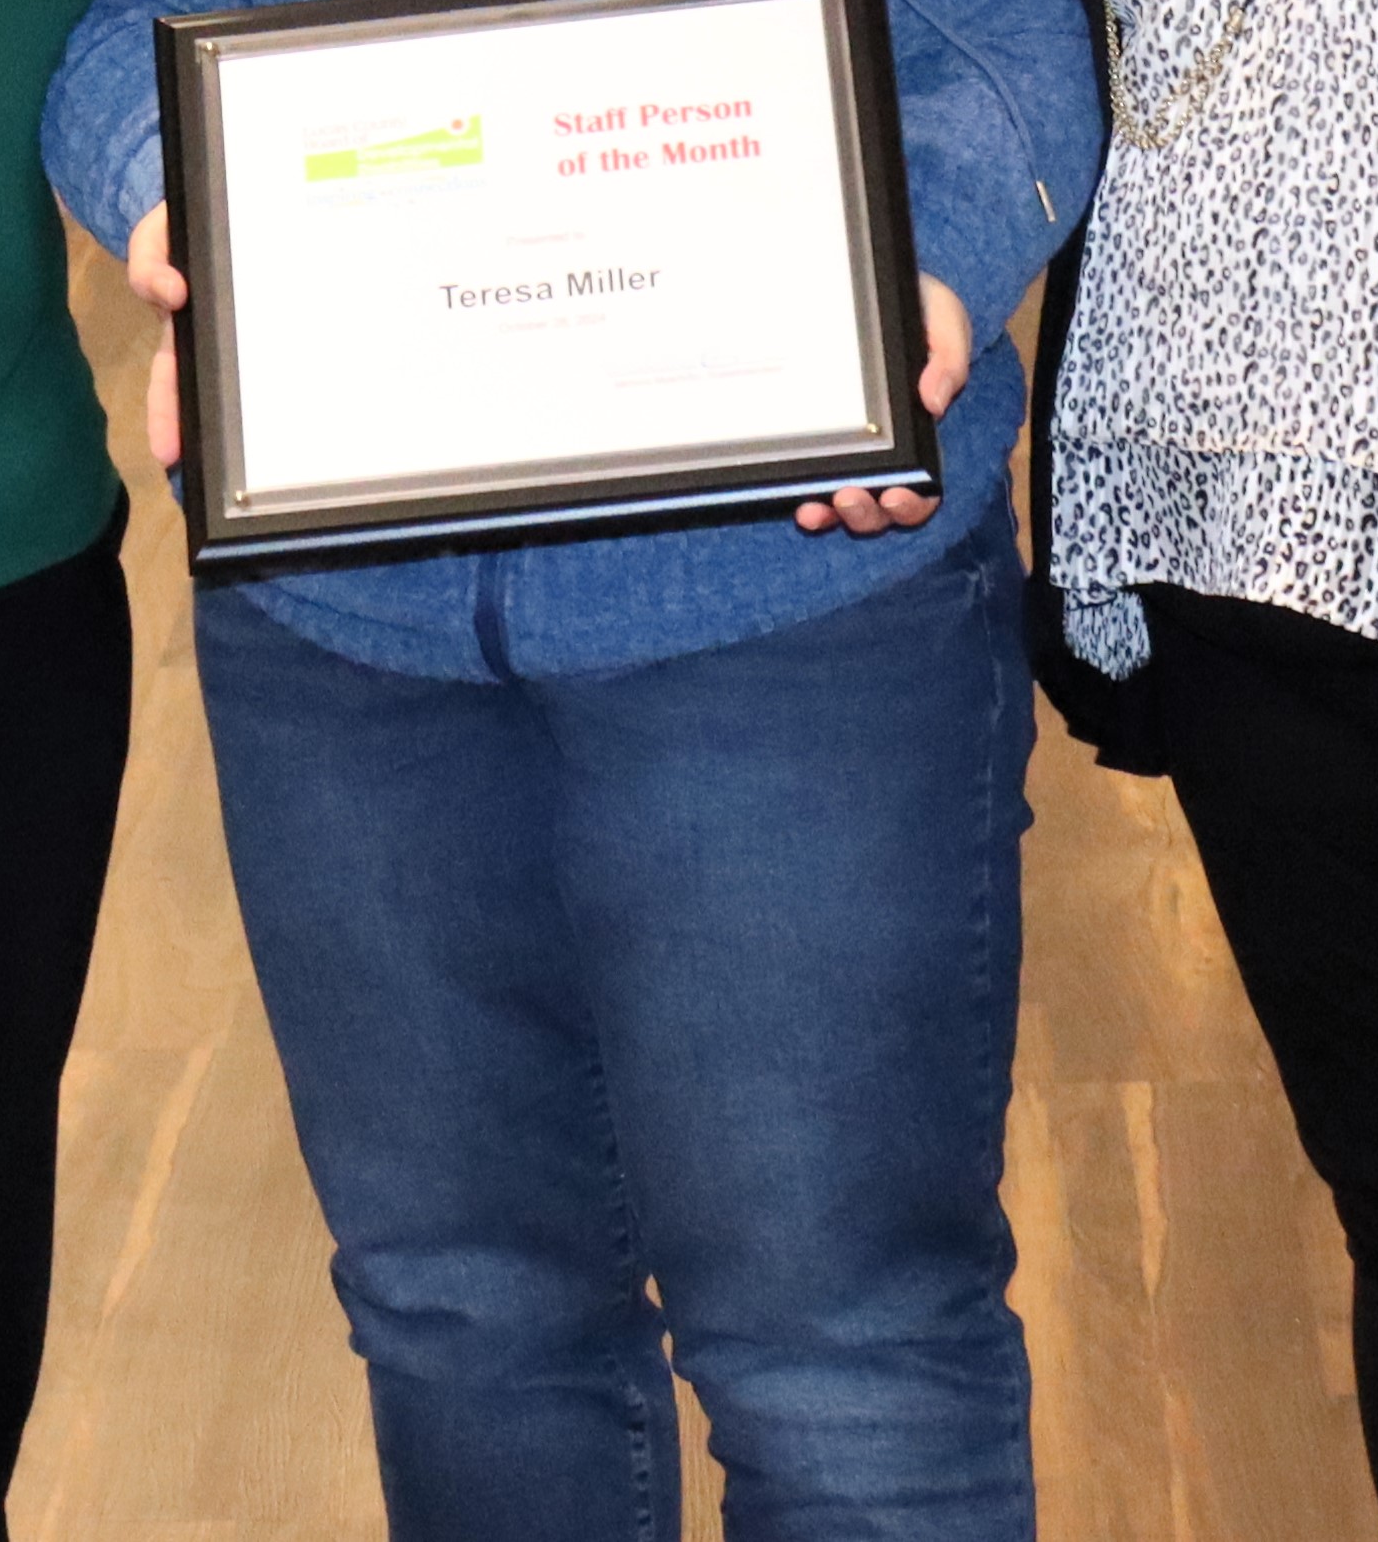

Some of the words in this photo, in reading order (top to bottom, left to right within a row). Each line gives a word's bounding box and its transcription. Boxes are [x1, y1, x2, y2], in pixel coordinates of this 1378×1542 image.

[553, 106, 627, 137] Staff
[639, 98, 753, 128] Person
[557, 150, 588, 177] of
[599, 147, 650, 172] the
[661, 135, 762, 165] Month
[438, 281, 554, 309] Teresa
[566, 267, 662, 297] Miller
